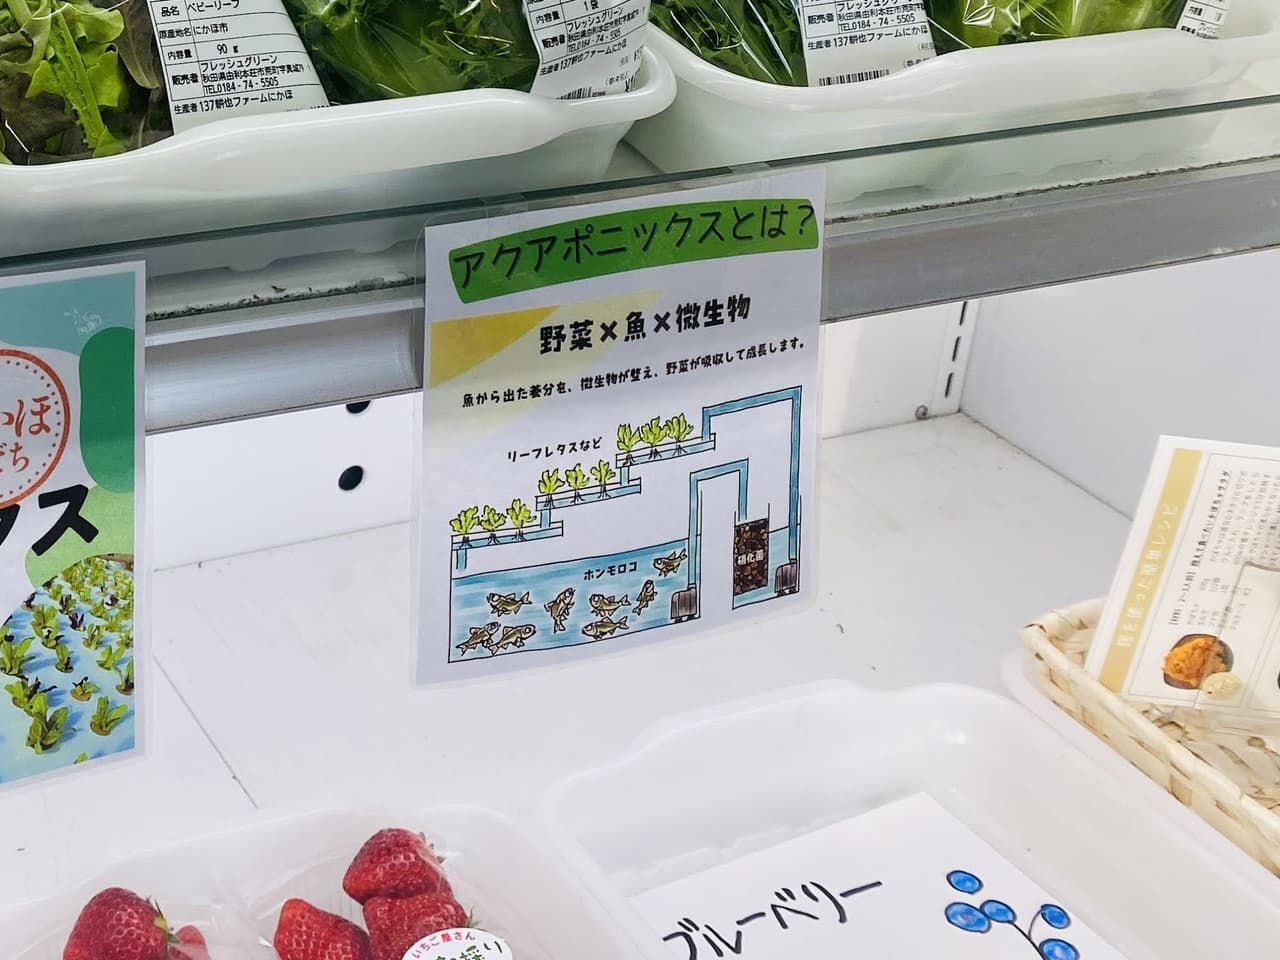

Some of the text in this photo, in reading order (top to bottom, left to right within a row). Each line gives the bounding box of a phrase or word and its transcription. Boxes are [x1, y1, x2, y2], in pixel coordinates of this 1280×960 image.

[161, 6, 180, 17] 品名
[535, 10, 560, 24] 内容量
[567, 7, 624, 33] フレッシュグリーン
[194, 22, 229, 36] にかほ市
[167, 49, 193, 60] 内容量
[217, 44, 228, 54] 90
[808, 40, 831, 50] 生産者
[201, 55, 278, 72] フレッシュグリーン
[172, 72, 199, 86] 販売者
[173, 103, 198, 115] 生産者
[506, 436, 601, 463] リーフレタスなど
[583, 562, 638, 581] ホンモロコ
[662, 881, 882, 960] ブルーベリー
